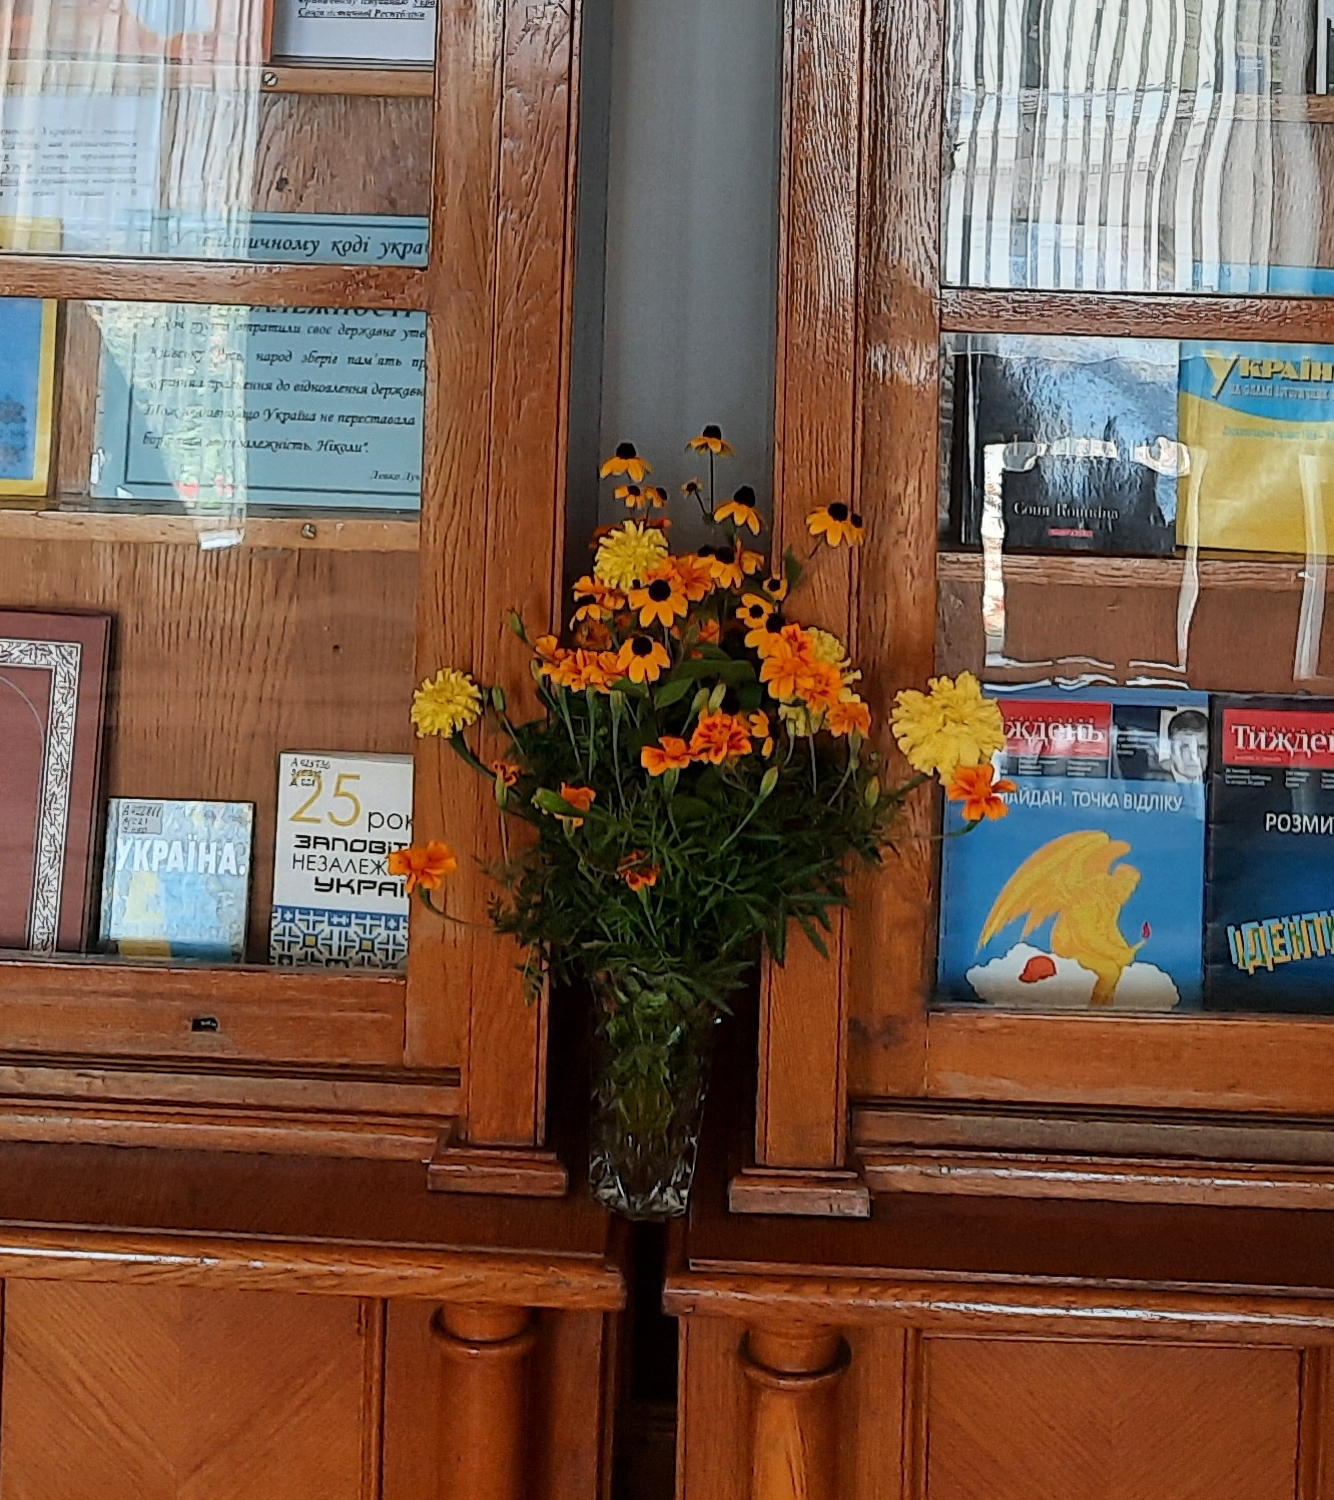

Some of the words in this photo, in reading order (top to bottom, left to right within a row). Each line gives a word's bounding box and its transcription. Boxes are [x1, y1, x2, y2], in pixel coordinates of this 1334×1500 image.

[332, 235, 369, 257] коді
[255, 352, 292, 366] народ
[264, 409, 316, 425] Україна
[320, 413, 334, 422] не
[338, 415, 415, 427] переставала
[289, 770, 363, 828] 25
[1071, 791, 1118, 809] ТОЧКА
[1123, 794, 1184, 814] ВІДЛІКУ
[116, 833, 247, 877] УКРАЇНА.
